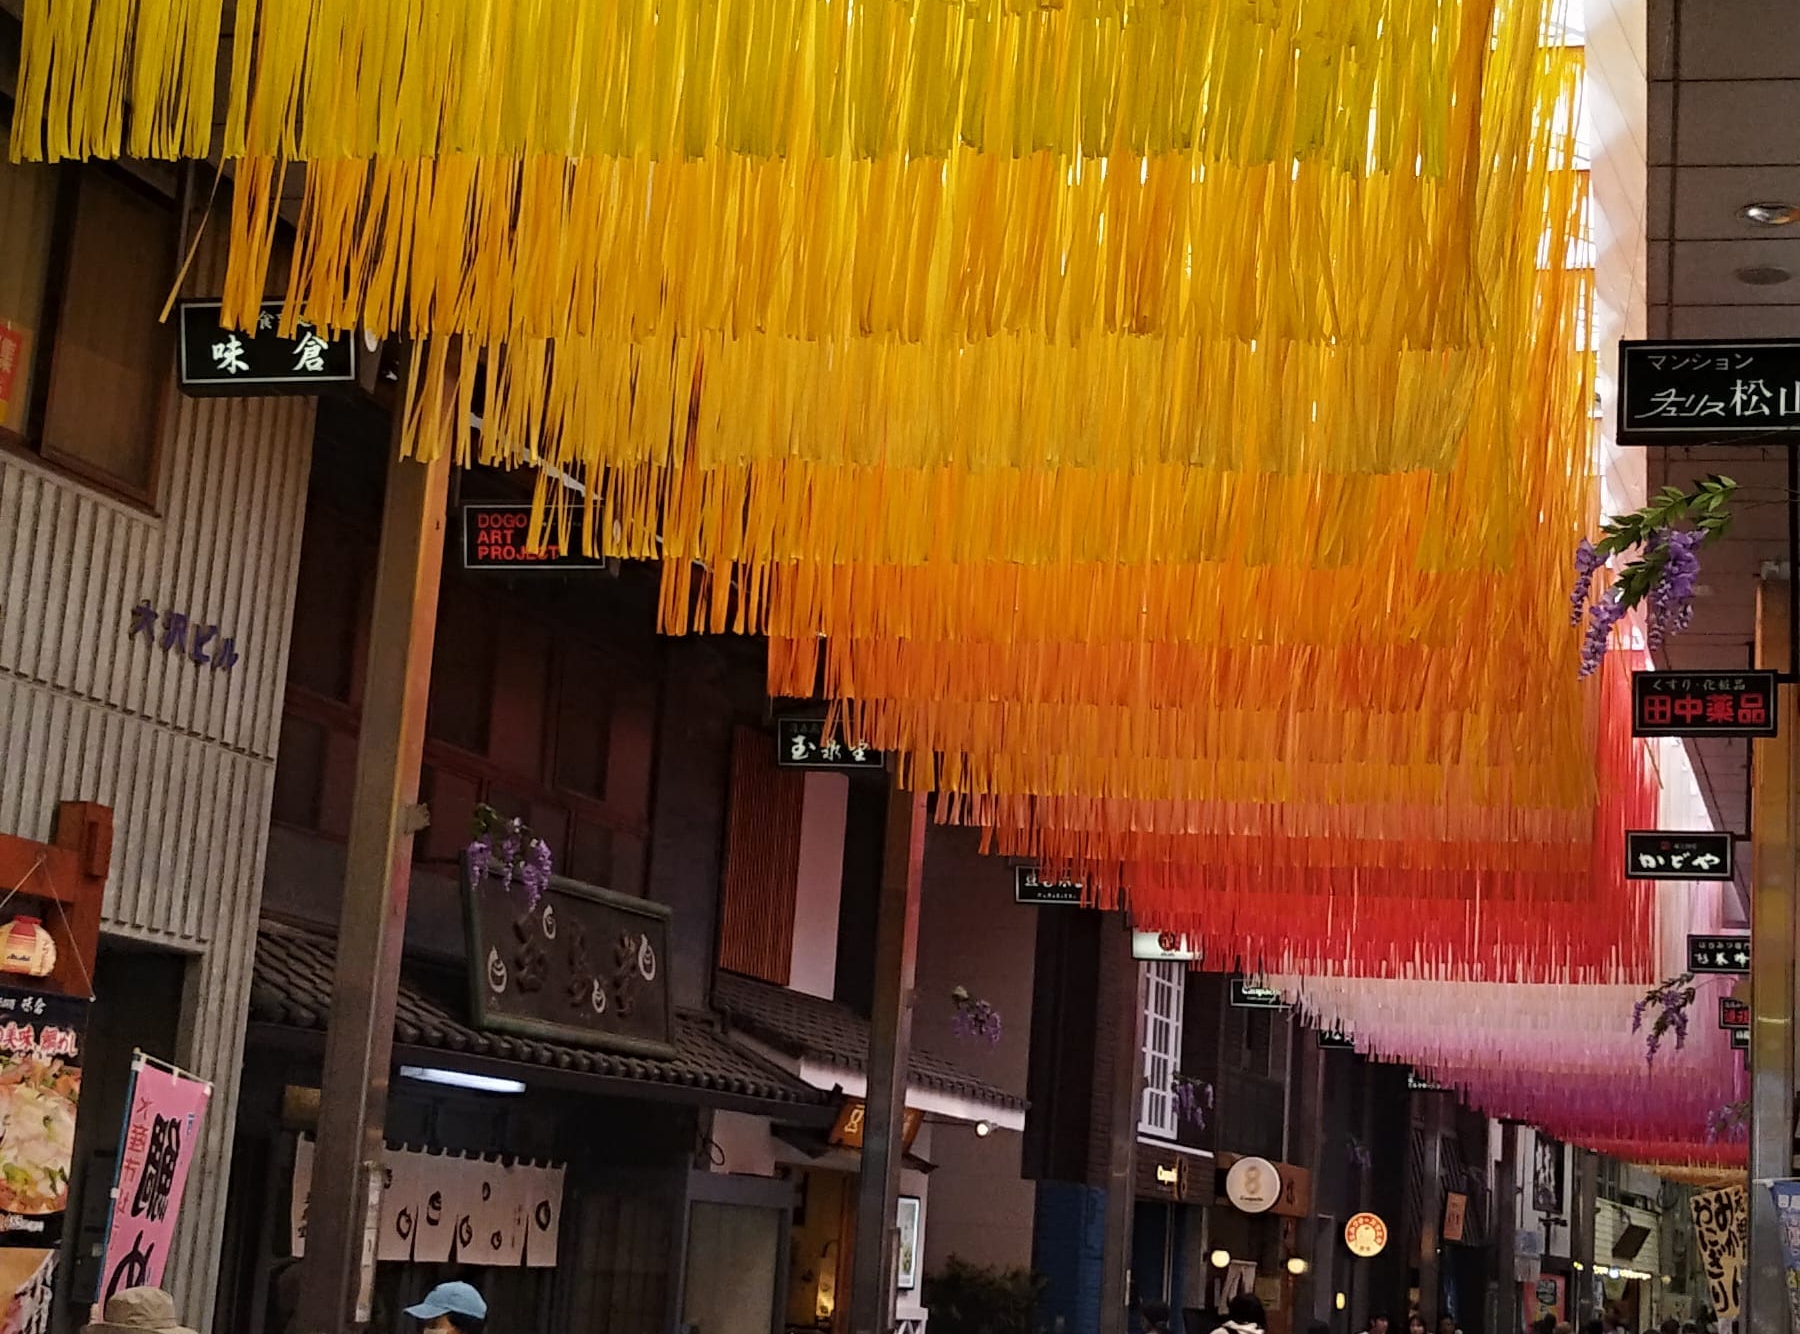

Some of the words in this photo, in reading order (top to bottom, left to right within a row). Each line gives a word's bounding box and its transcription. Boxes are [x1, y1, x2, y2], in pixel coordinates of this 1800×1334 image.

[211, 331, 329, 375] 味倉
[1647, 353, 1754, 370] マンション
[477, 513, 528, 528] DOGO
[477, 529, 514, 544] ART
[1643, 693, 1766, 724] 田中薬品
[1638, 851, 1721, 870] かどや
[1694, 1196, 1730, 1313] おにぎり
[1714, 1191, 1741, 1309] みか
